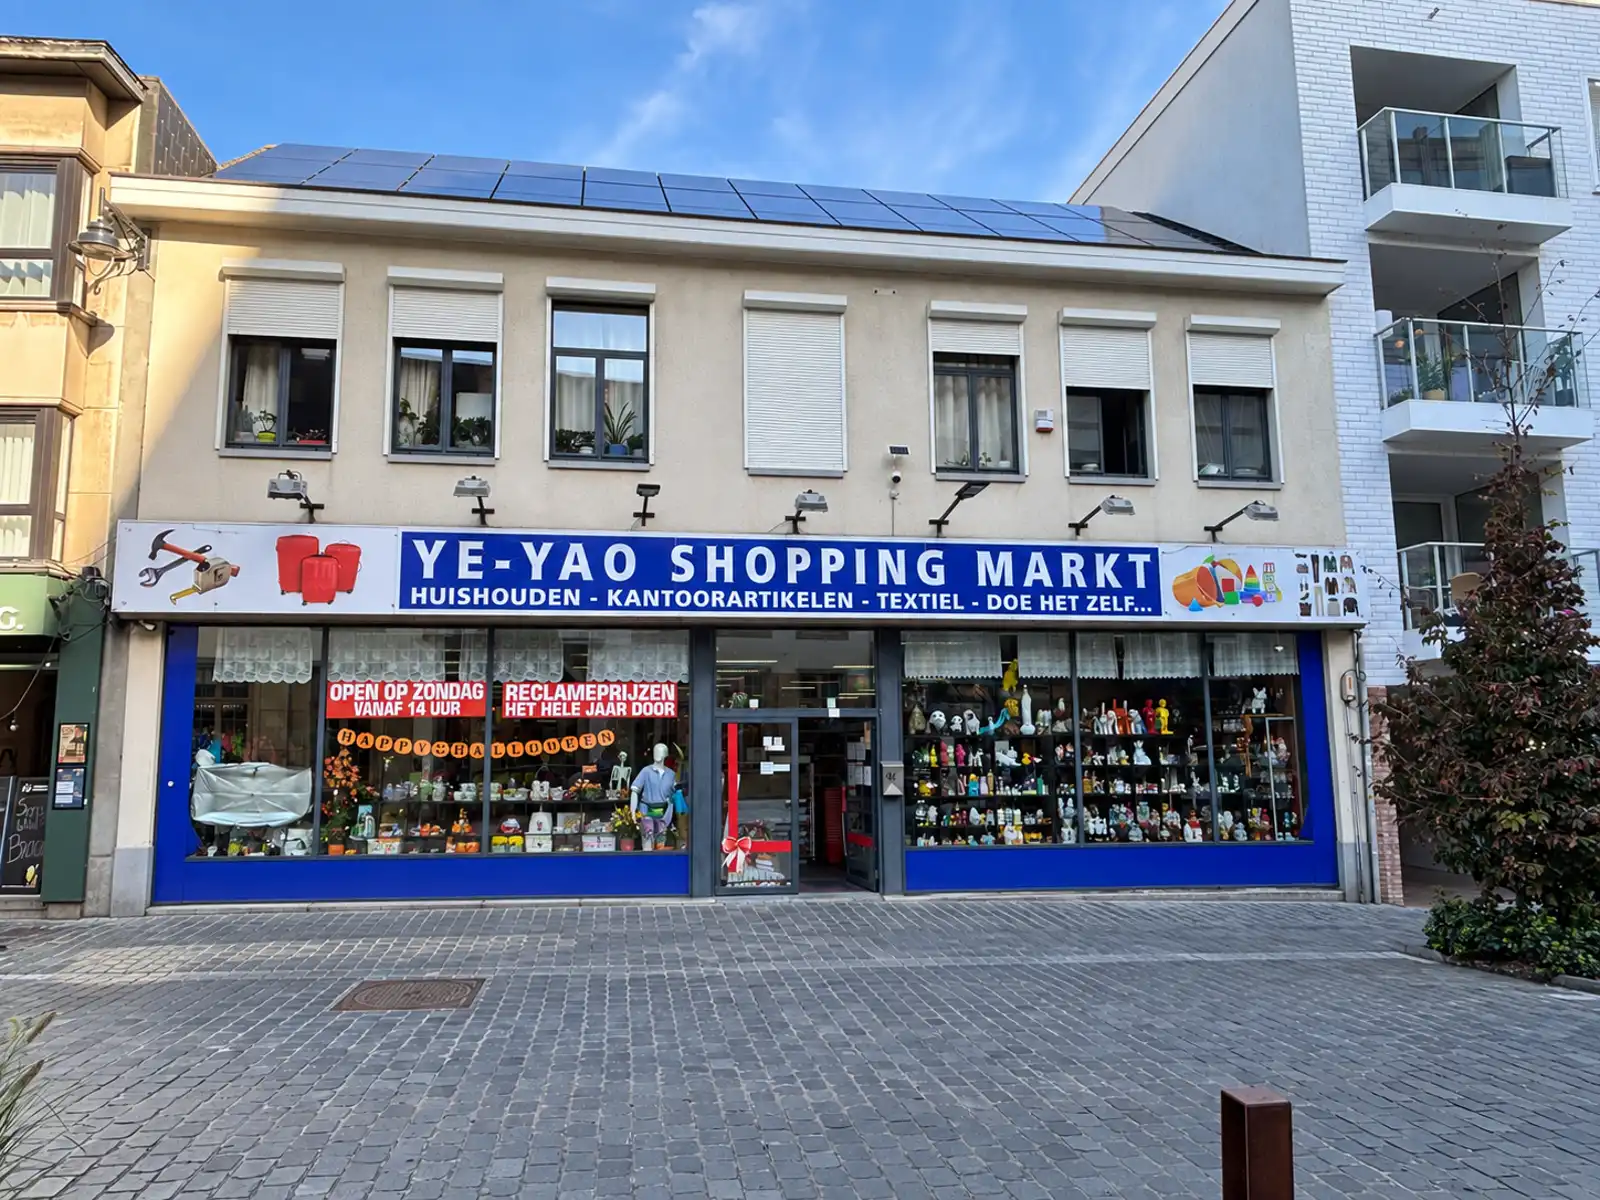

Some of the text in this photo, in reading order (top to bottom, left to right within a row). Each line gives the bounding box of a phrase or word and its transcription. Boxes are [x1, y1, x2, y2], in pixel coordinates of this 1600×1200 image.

[412, 539, 1152, 589] YE-YAO SHOPPING MARKT
[411, 587, 581, 606] HUISHOUDEN
[607, 588, 853, 609] KANTOORARTIKELEN
[877, 592, 965, 610] TEXTIEL
[987, 594, 1032, 610] DOE
[1040, 594, 1080, 611] HET
[1087, 595, 1152, 612] ZELF...
[329, 682, 484, 701] OPEN OP ZONDAG
[505, 683, 675, 701] RECLAMEPRIJZEN
[354, 701, 461, 716] VANAF 14 UUR
[505, 702, 675, 716] HET HELE JAAR DOOR
[340, 730, 427, 755] HAPPY
